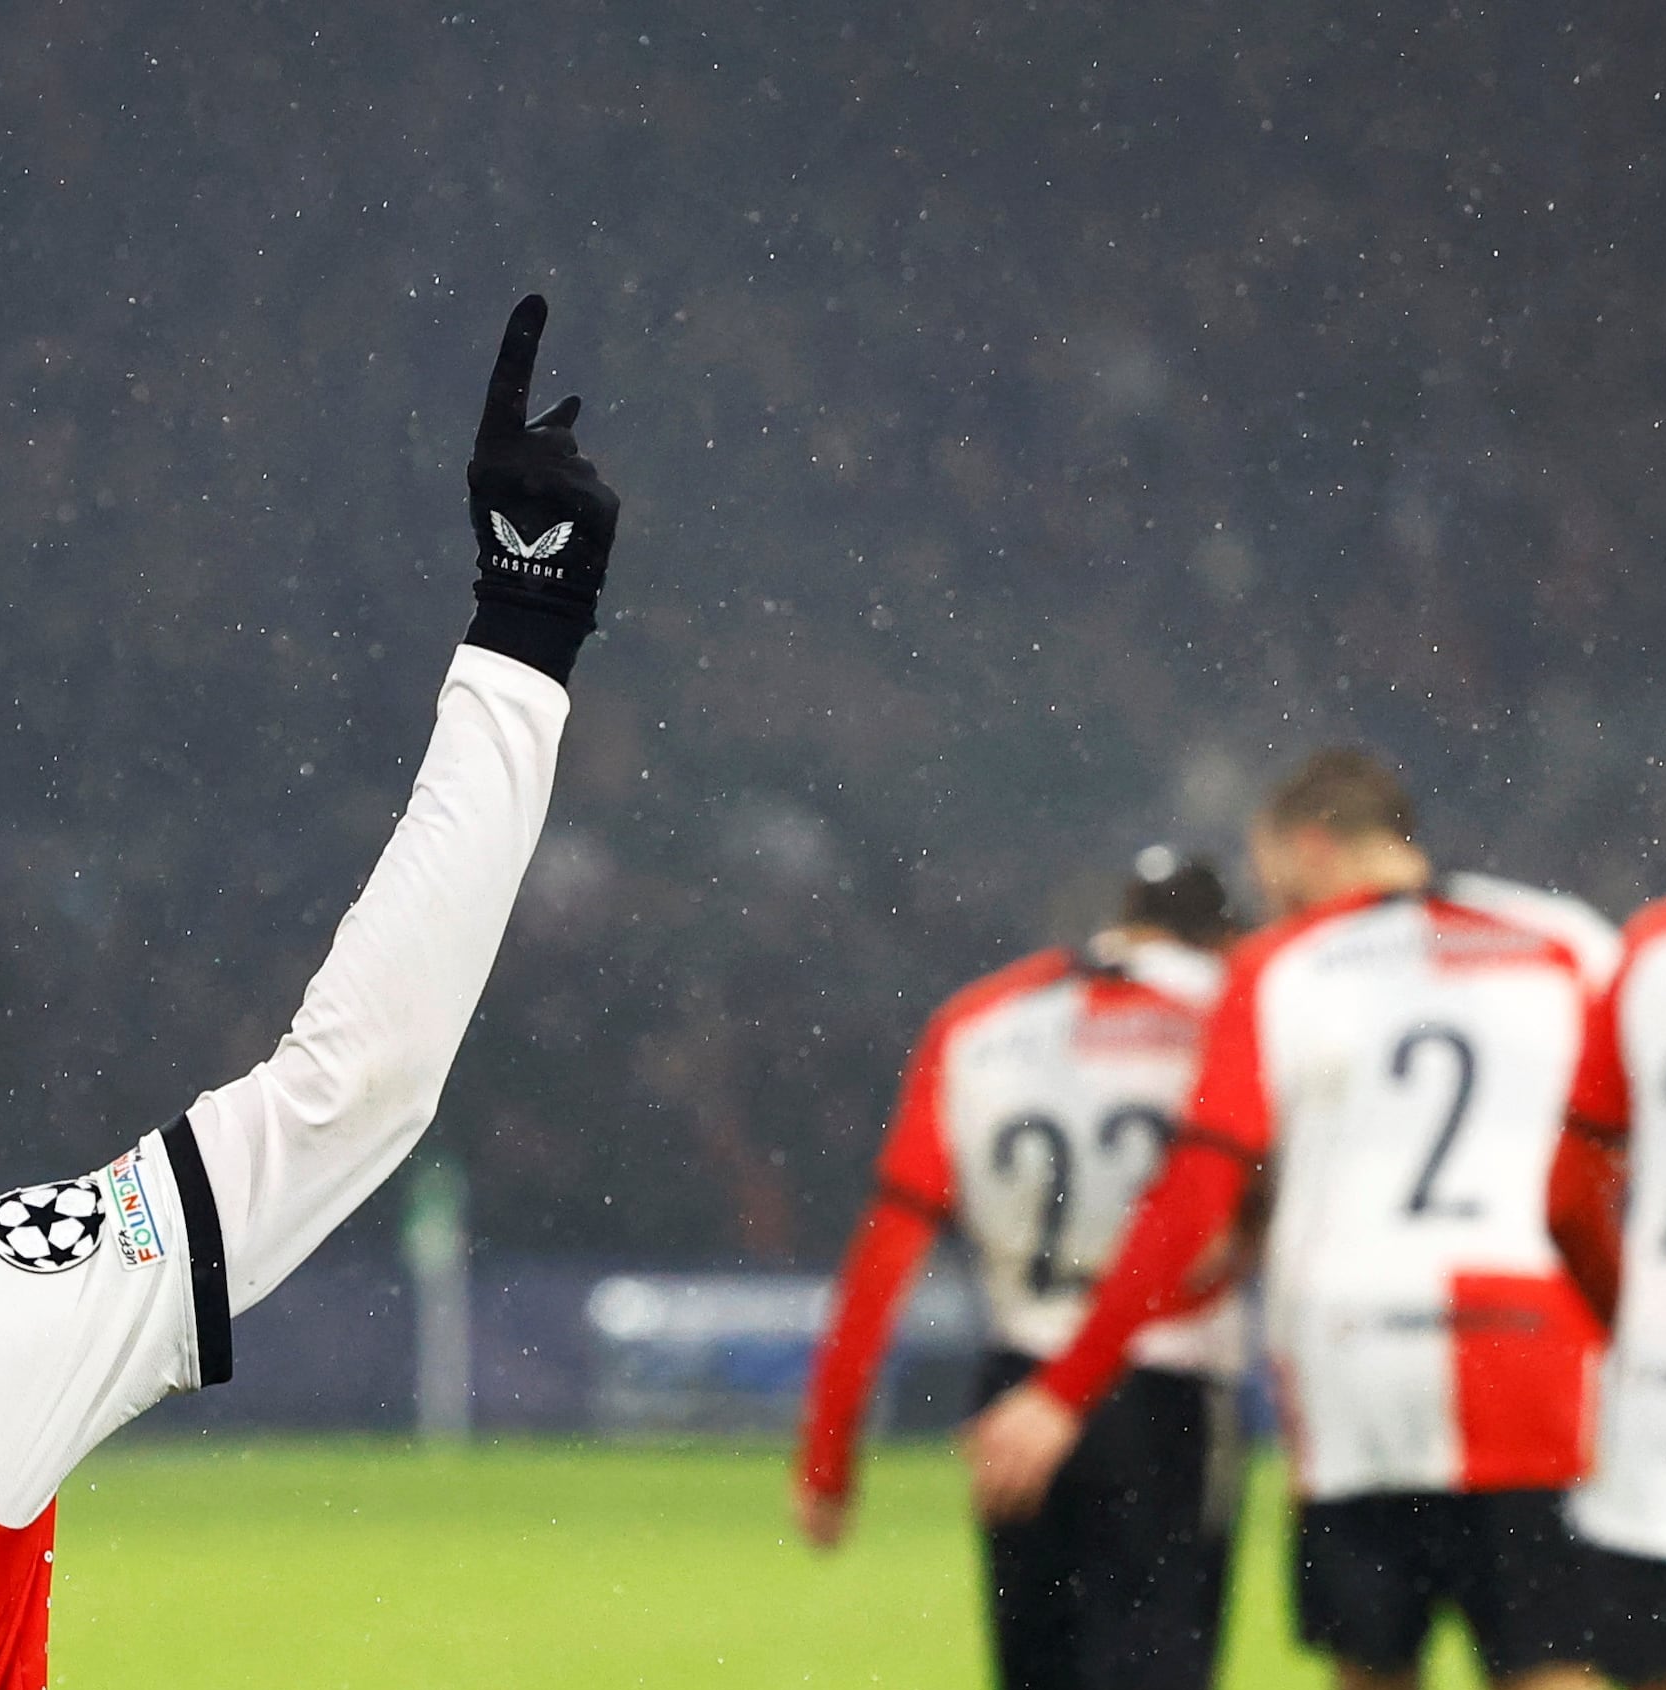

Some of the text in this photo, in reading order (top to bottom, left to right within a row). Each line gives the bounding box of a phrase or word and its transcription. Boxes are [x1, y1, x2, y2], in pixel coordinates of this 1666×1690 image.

[493, 555, 564, 578] CASTORE
[1392, 1023, 1482, 1217] 2
[118, 1229, 138, 1265] UEFA
